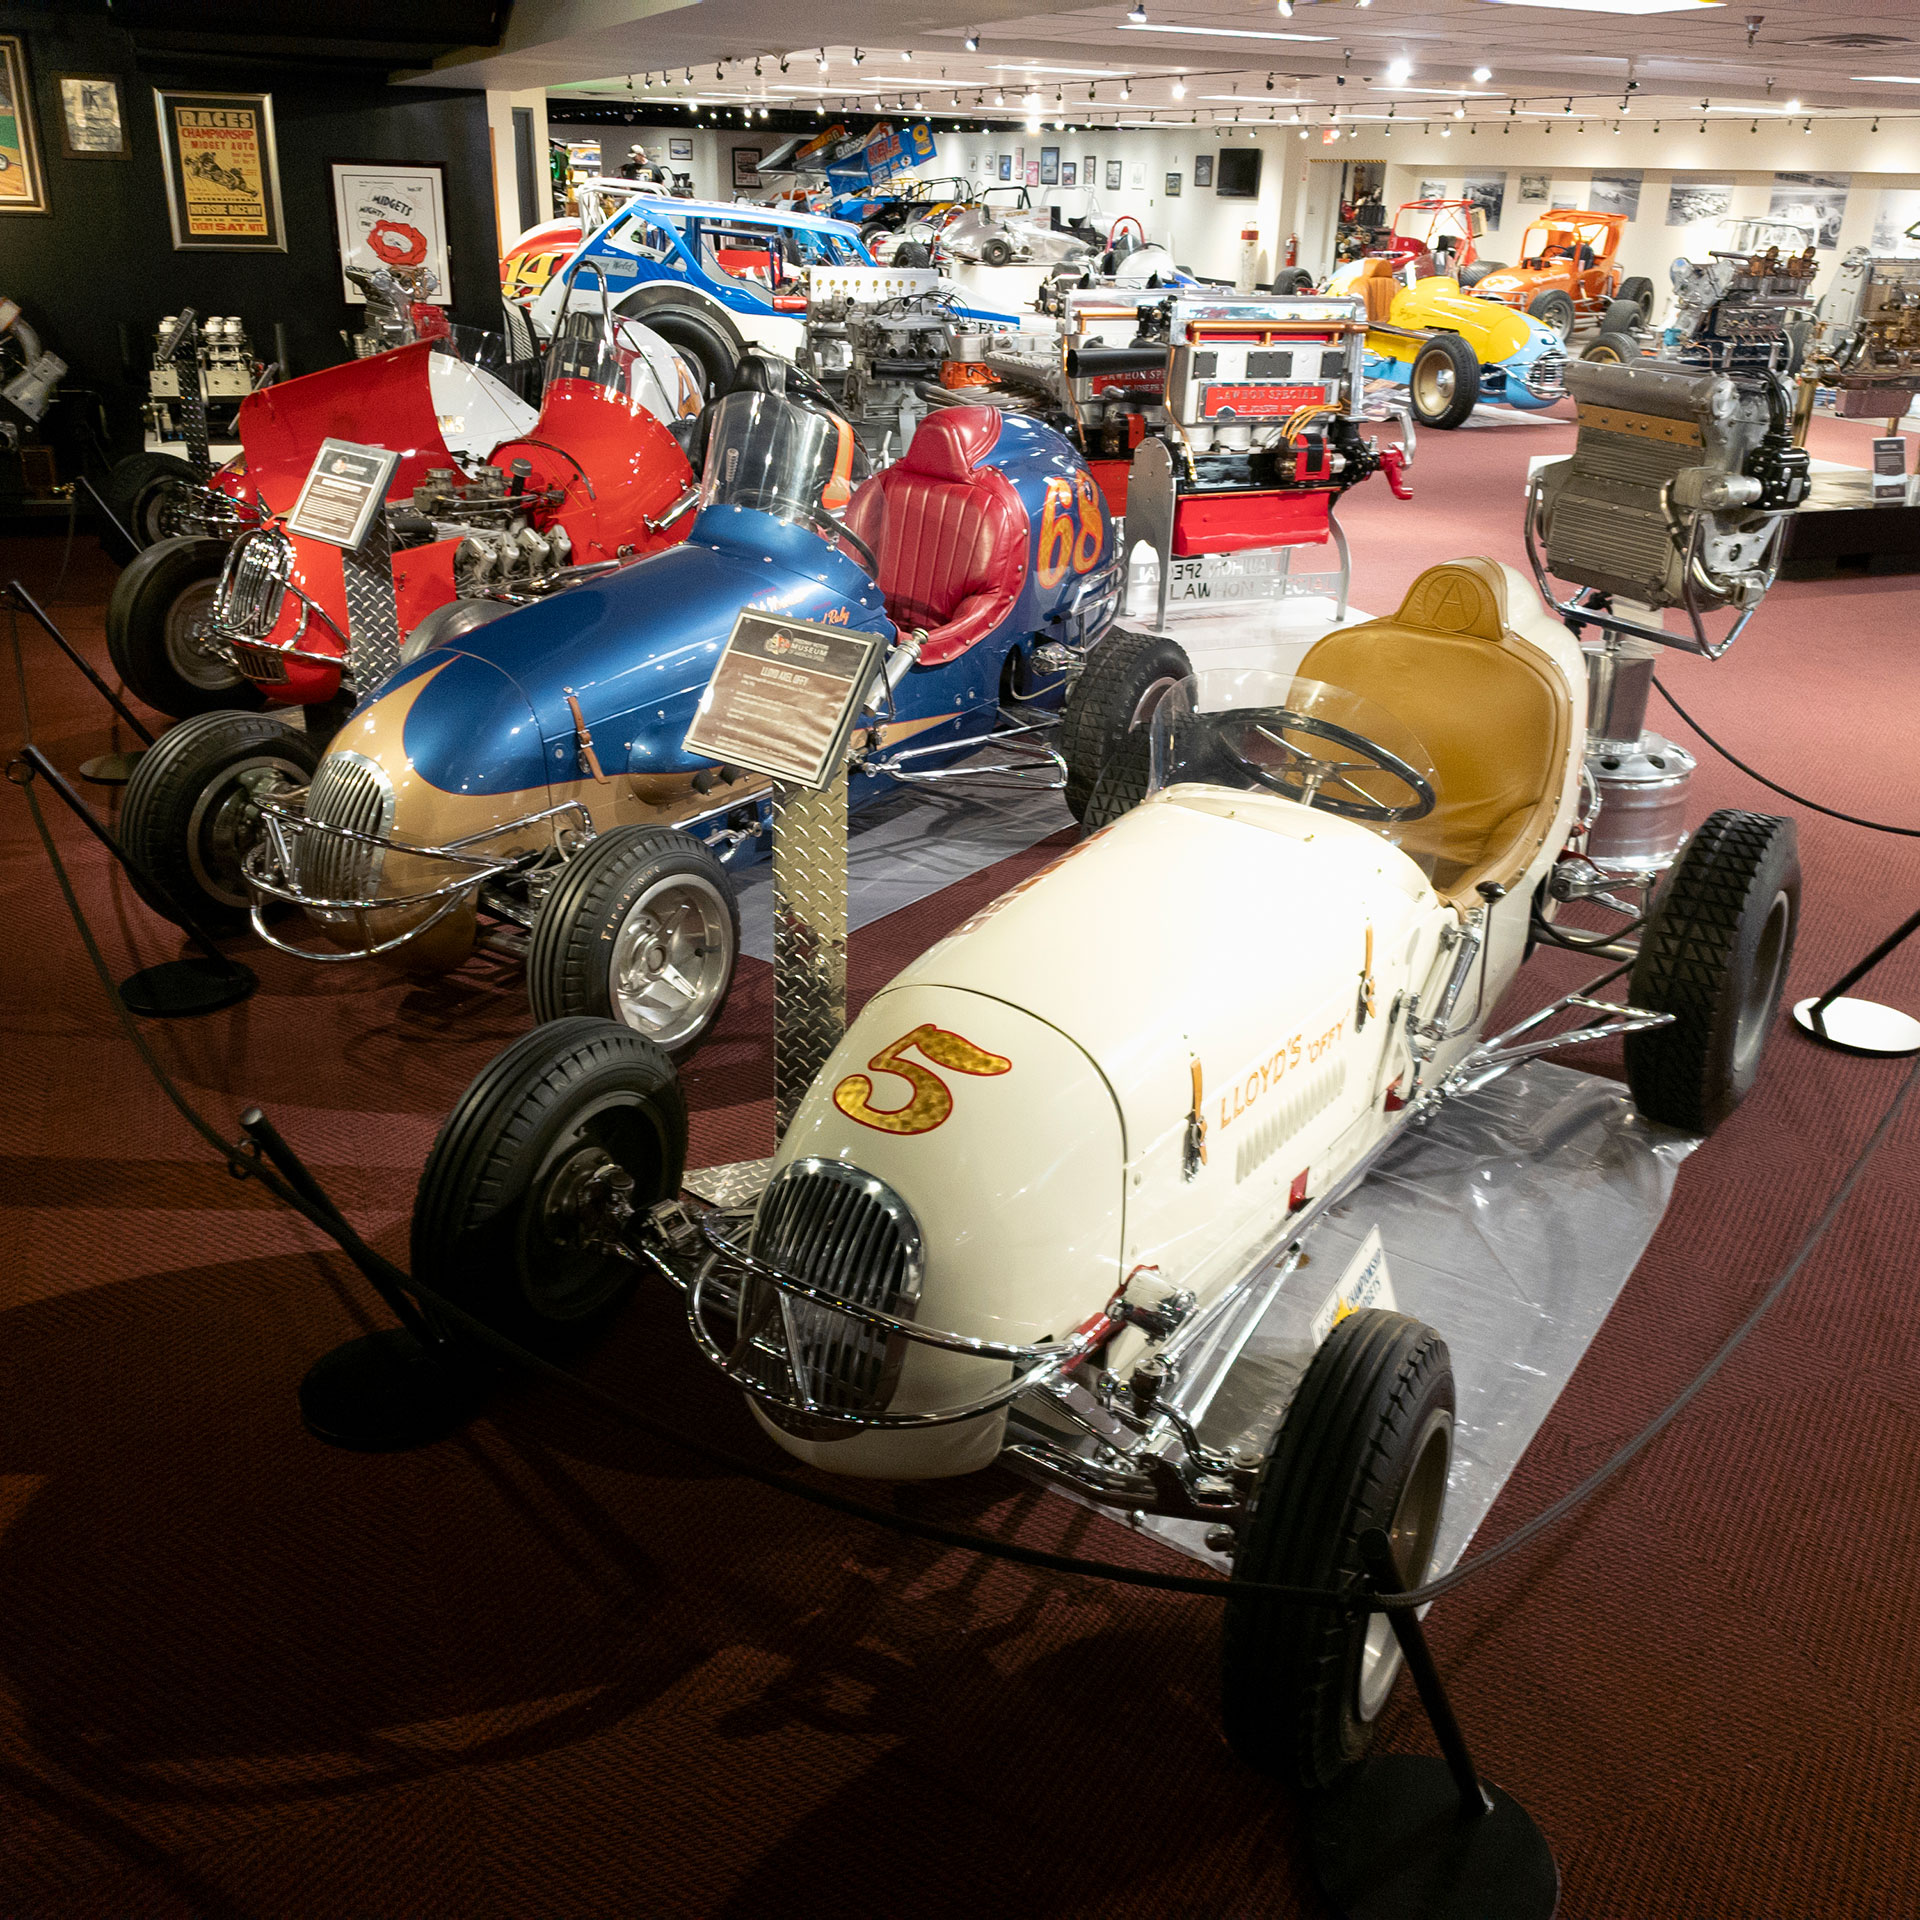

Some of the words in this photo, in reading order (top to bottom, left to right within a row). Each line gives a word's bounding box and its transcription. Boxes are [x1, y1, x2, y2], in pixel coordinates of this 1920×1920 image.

[180, 111, 252, 128] RACES
[181, 127, 254, 140] CHAMPIONSHIP
[191, 140, 226, 150] MIDGET
[231, 142, 255, 151] AUTO
[359, 206, 386, 219] MIGHTY
[372, 194, 414, 217] MIDGETS
[191, 222, 214, 231] EVERY
[248, 223, 265, 232] NITE
[502, 252, 563, 299] 14
[1216, 389, 1265, 400] LAWHON
[1268, 389, 1318, 400] SPECIAL
[1037, 468, 1104, 590] 68
[1170, 581, 1255, 601] LAWHON
[1262, 576, 1337, 596] SPECIAL
[791, 643, 828, 657] MUSEUM
[832, 1023, 1013, 1136] 5
[1220, 1033, 1302, 1131] LLOYD'S
